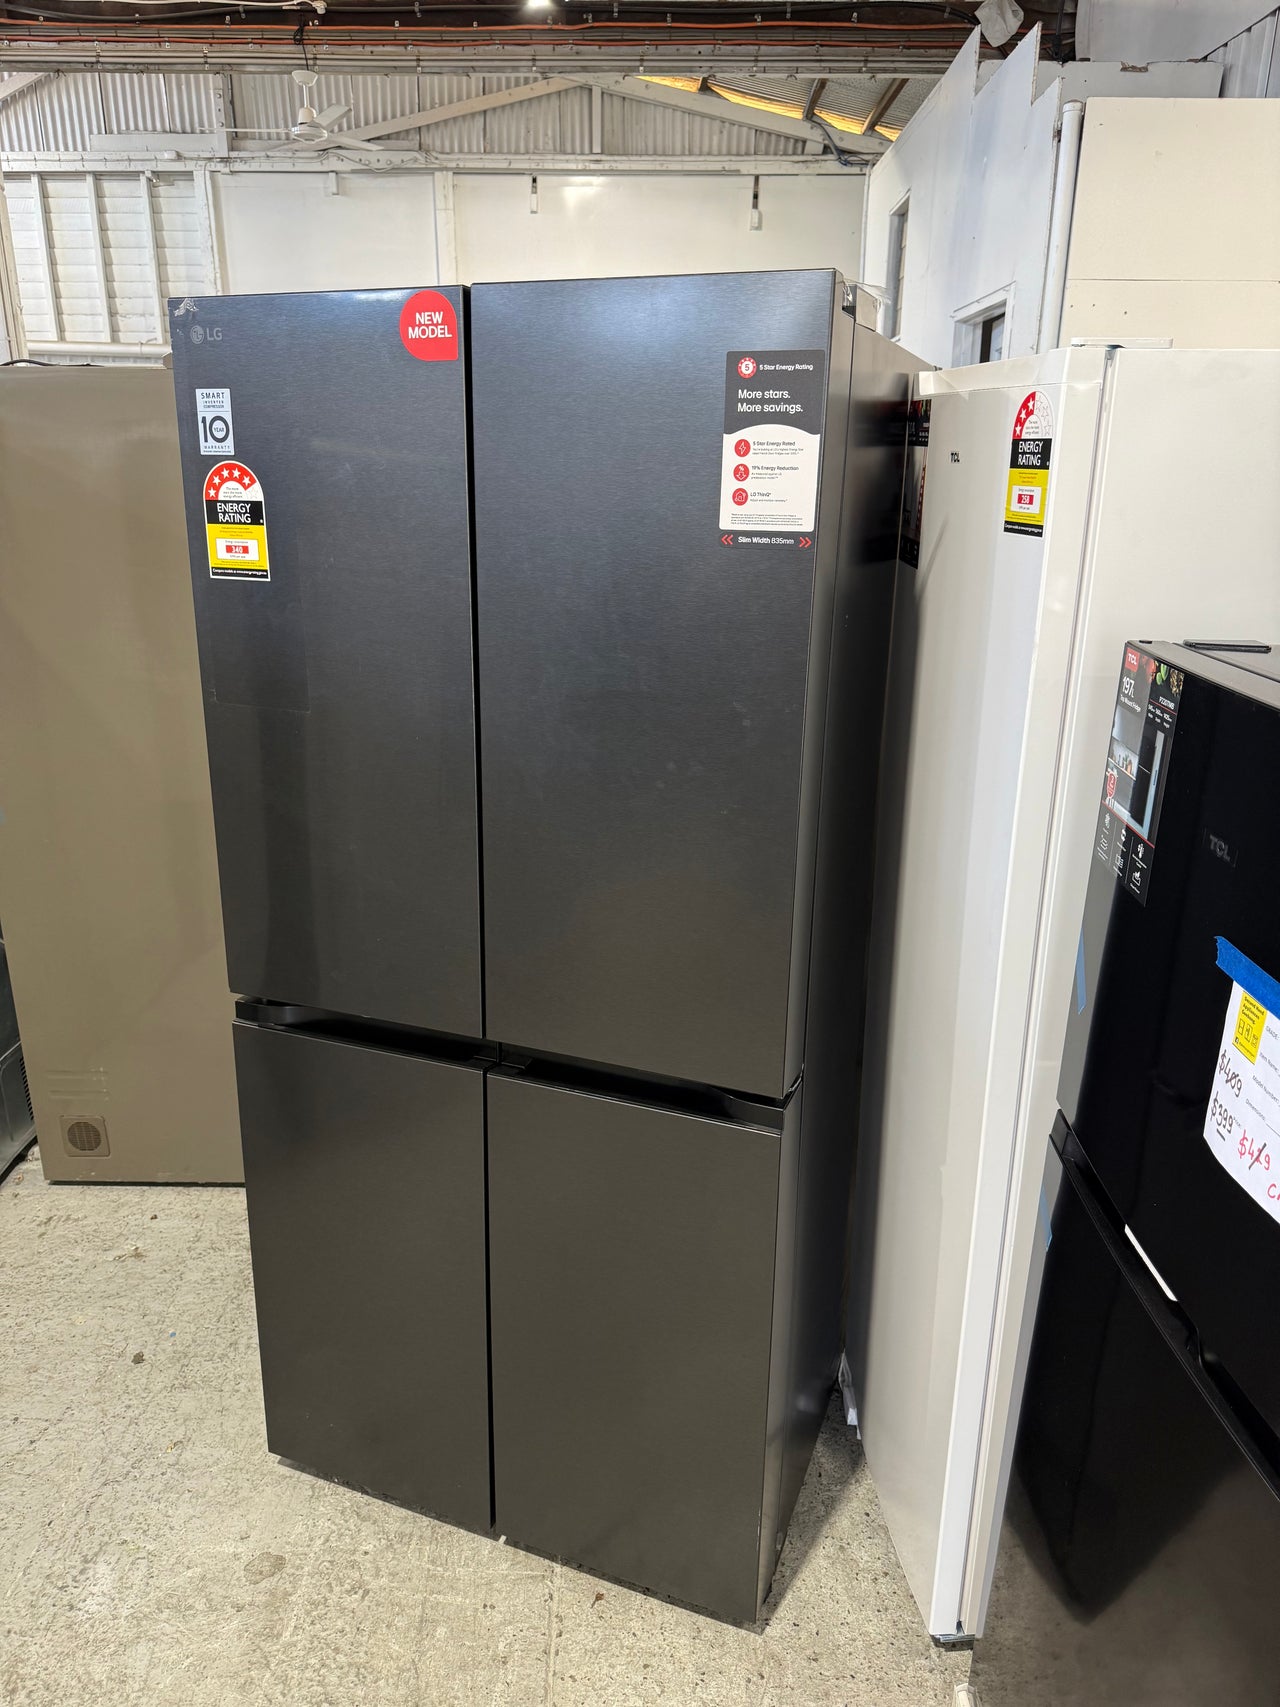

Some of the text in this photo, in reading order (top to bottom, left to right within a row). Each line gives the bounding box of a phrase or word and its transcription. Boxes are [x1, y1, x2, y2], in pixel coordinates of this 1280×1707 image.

[415, 311, 444, 325] NEW
[206, 327, 223, 341] LG
[408, 325, 453, 339] MODEL
[744, 363, 750, 372] 5
[776, 364, 795, 372] Energy
[795, 363, 814, 371] Rating
[200, 392, 225, 400] SMART
[738, 388, 791, 399] More stars.
[737, 402, 804, 414] More savings.
[201, 415, 231, 443] 10
[1019, 440, 1044, 453] ENERGY
[950, 452, 960, 463] TCL
[1017, 454, 1042, 467] RATING
[216, 503, 251, 513] ENERGY
[218, 513, 252, 523] RATING
[771, 537, 795, 545] 835mm
[1128, 653, 1138, 665] TCL
[1209, 833, 1231, 862] TCL
[1210, 1090, 1234, 1135] $399
